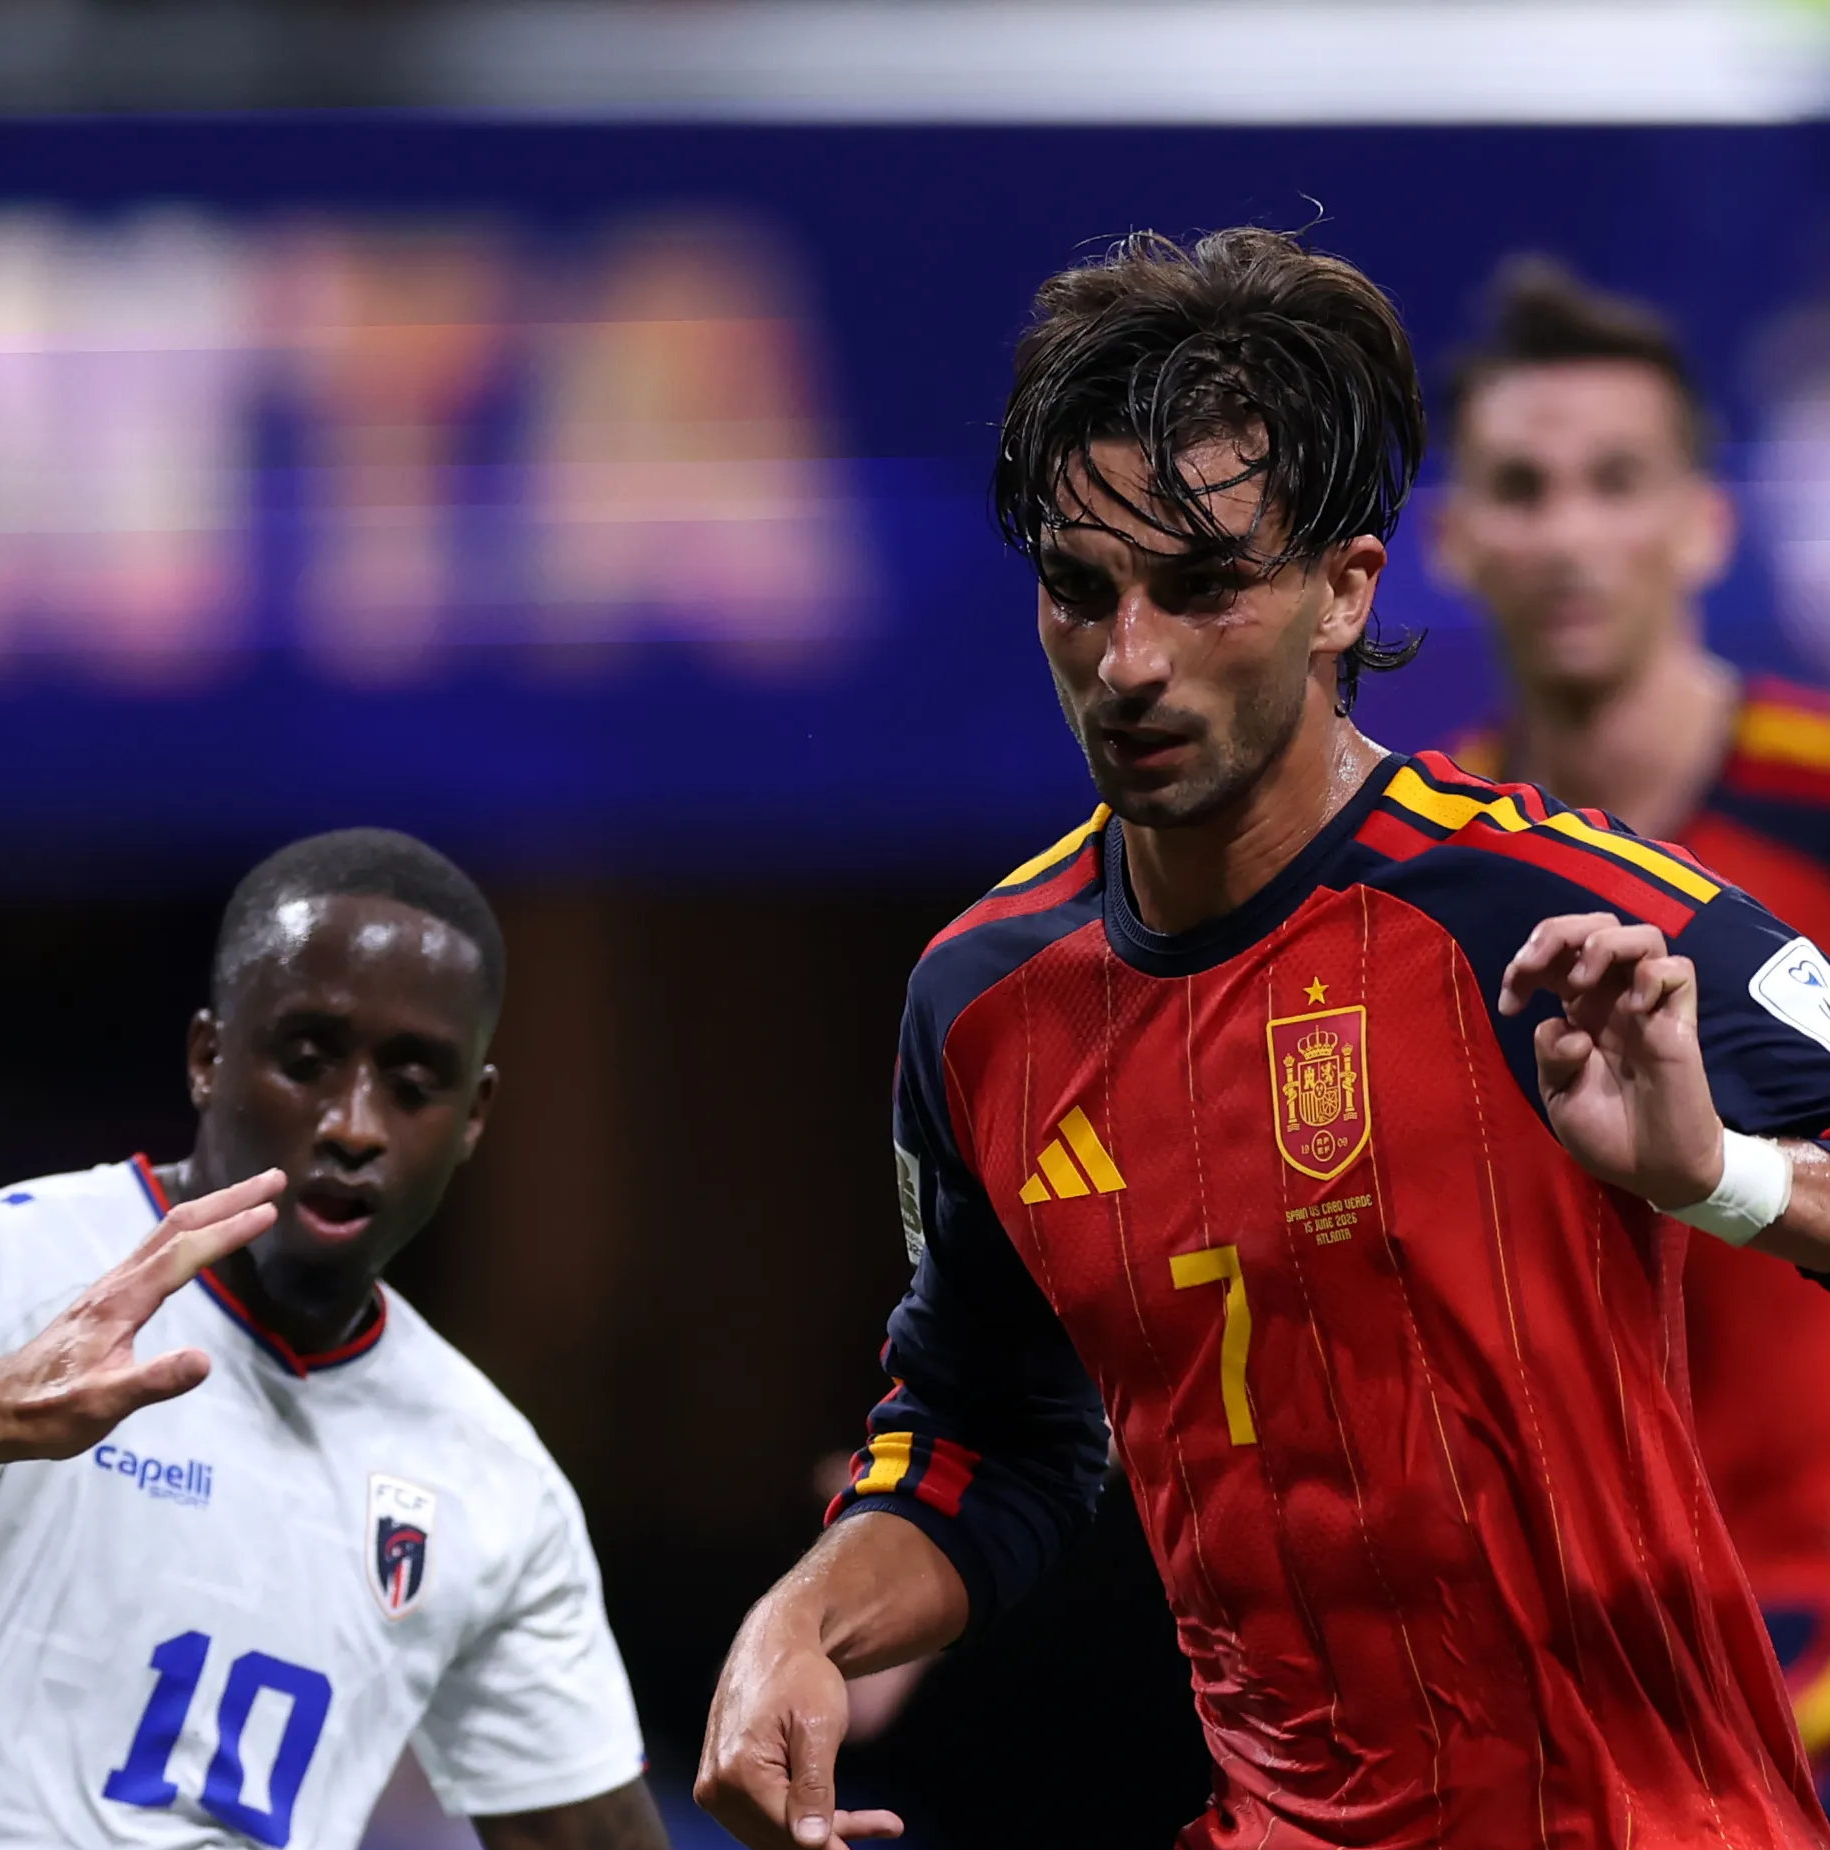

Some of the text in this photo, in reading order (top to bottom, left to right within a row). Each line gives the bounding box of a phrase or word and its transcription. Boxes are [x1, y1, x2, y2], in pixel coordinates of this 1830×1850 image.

[1286, 1208, 1308, 1222] SPAIN
[1321, 1201, 1343, 1215] CABO
[1344, 1195, 1373, 1210] VERDE
[1304, 1213, 1358, 1234] 15 JUNE 2026
[1316, 1229, 1352, 1246] ATLANTA
[1170, 1245, 1256, 1445] 7
[95, 1444, 213, 1498] capelli
[102, 1630, 333, 1850] 10
